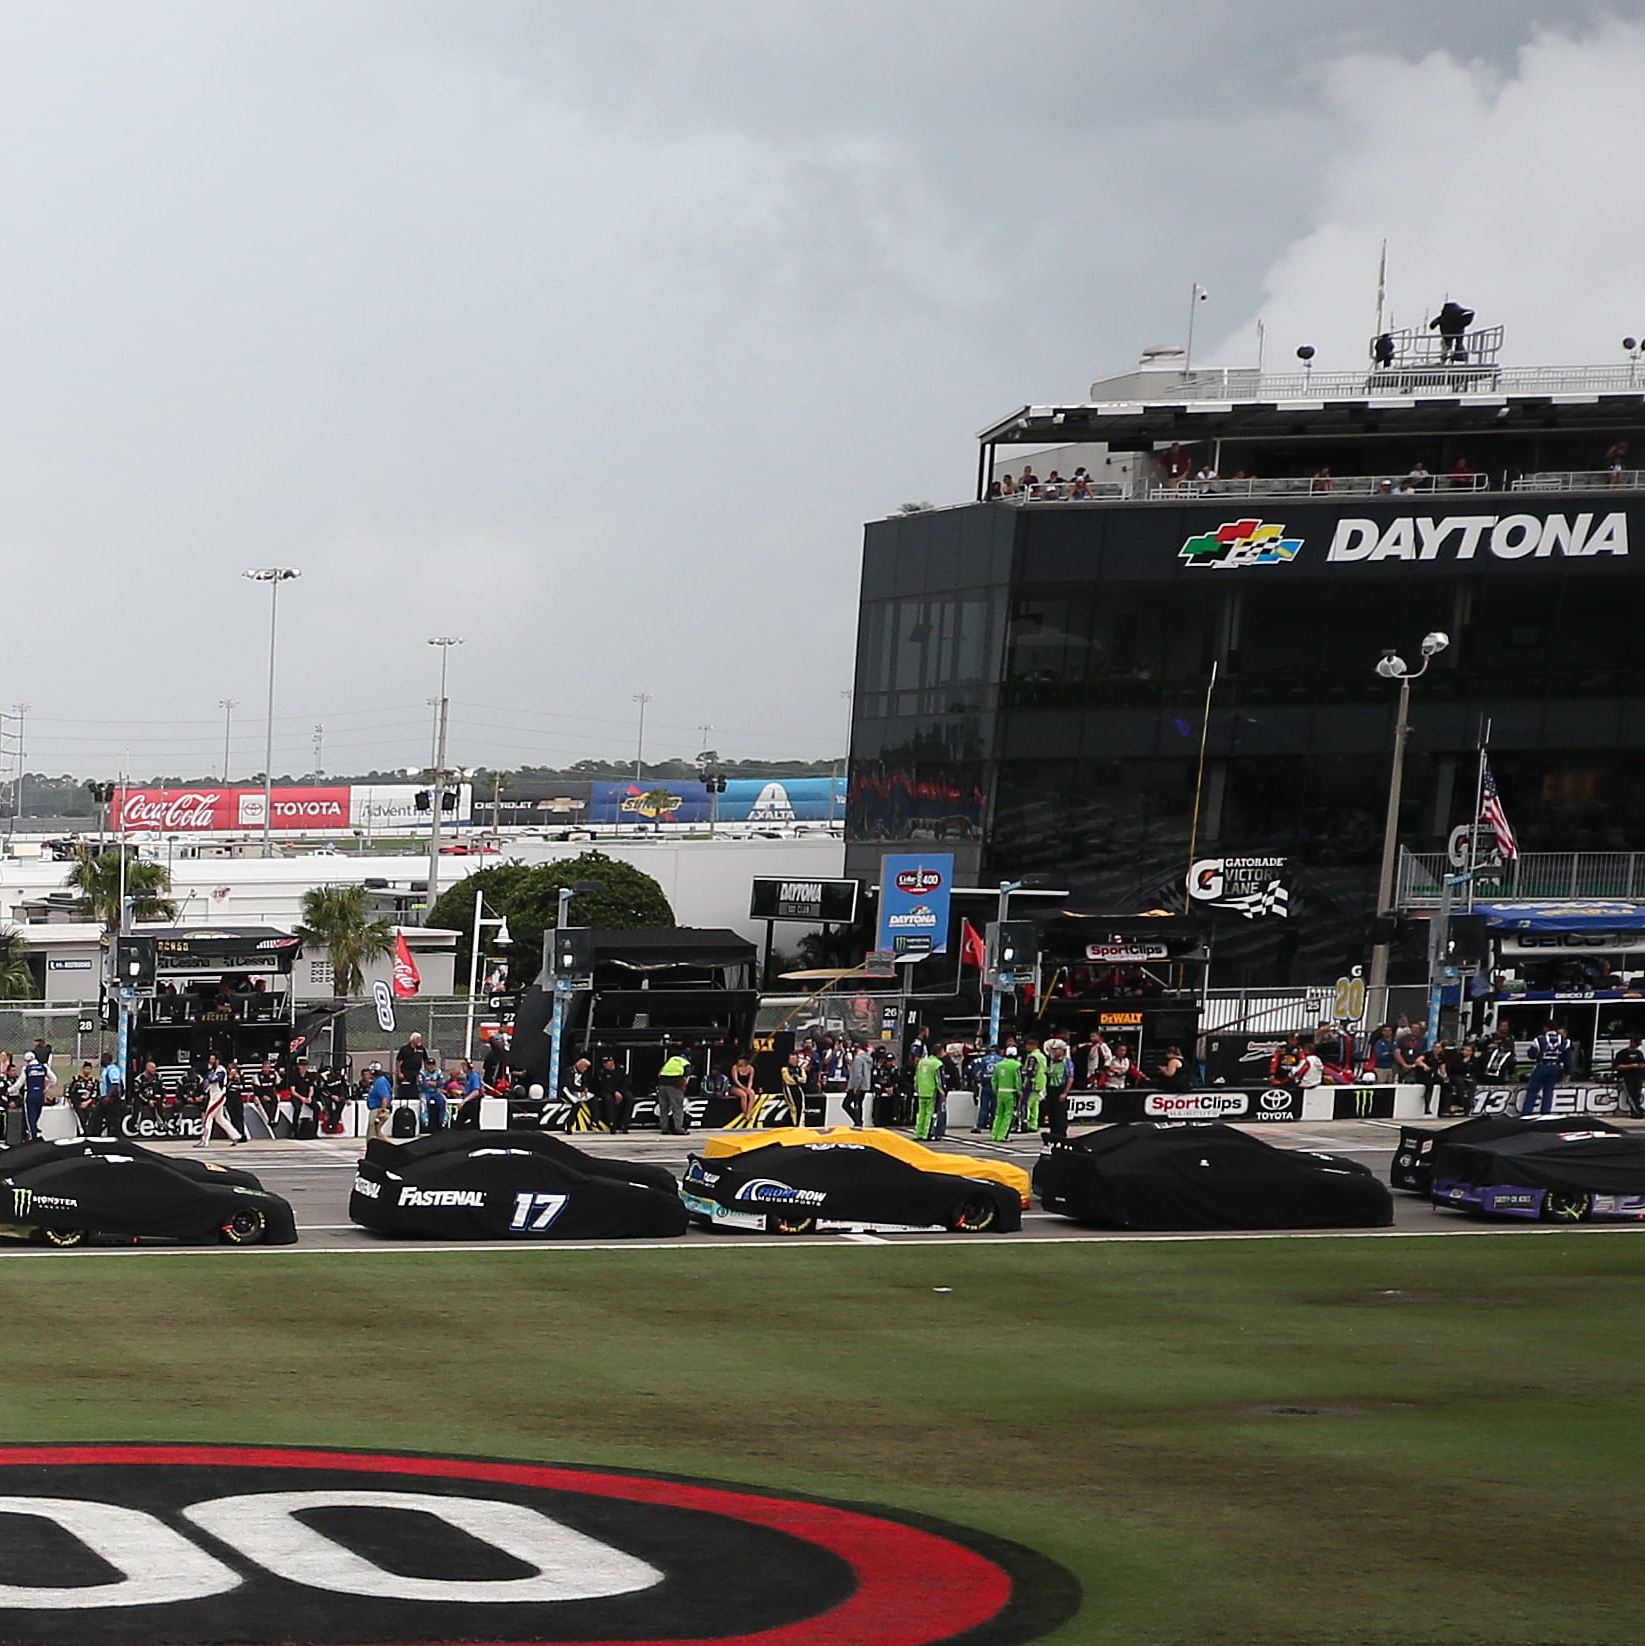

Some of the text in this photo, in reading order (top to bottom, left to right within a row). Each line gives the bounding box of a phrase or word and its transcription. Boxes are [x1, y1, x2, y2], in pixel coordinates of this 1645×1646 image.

[1326, 512, 1630, 562] DAYTONA
[121, 793, 221, 827] Coca-Cola
[274, 801, 341, 816] TOYOTA
[748, 809, 796, 820] AXALTA
[1225, 857, 1283, 867] GATORADE
[922, 874, 939, 886] 400
[1225, 868, 1281, 881] VICTORY
[780, 883, 822, 903] DAYTONA
[1225, 882, 1260, 894] LANE
[889, 914, 938, 925] DAYTONA
[1518, 934, 1606, 948] GEICO
[1090, 944, 1163, 957] SportClips
[170, 956, 210, 968] Cessna
[235, 955, 276, 967] Cessna
[1333, 976, 1365, 1021] 20
[373, 979, 396, 1032] 8
[1307, 1001, 1319, 1011] 25
[503, 1013, 516, 1022] 27
[884, 1007, 898, 1018] 26
[79, 1020, 93, 1031] 28
[1151, 1095, 1243, 1112] SportClips
[1471, 1089, 1510, 1114] 13
[539, 1103, 571, 1125] 77
[758, 1101, 792, 1122] 77
[1256, 1111, 1294, 1121] TOYOTA
[120, 1111, 205, 1139] Cessna
[32, 1195, 78, 1208] MONSTER
[398, 1187, 486, 1207] FASTENAL
[795, 1189, 827, 1202] ROW
[511, 1193, 569, 1230] 17
